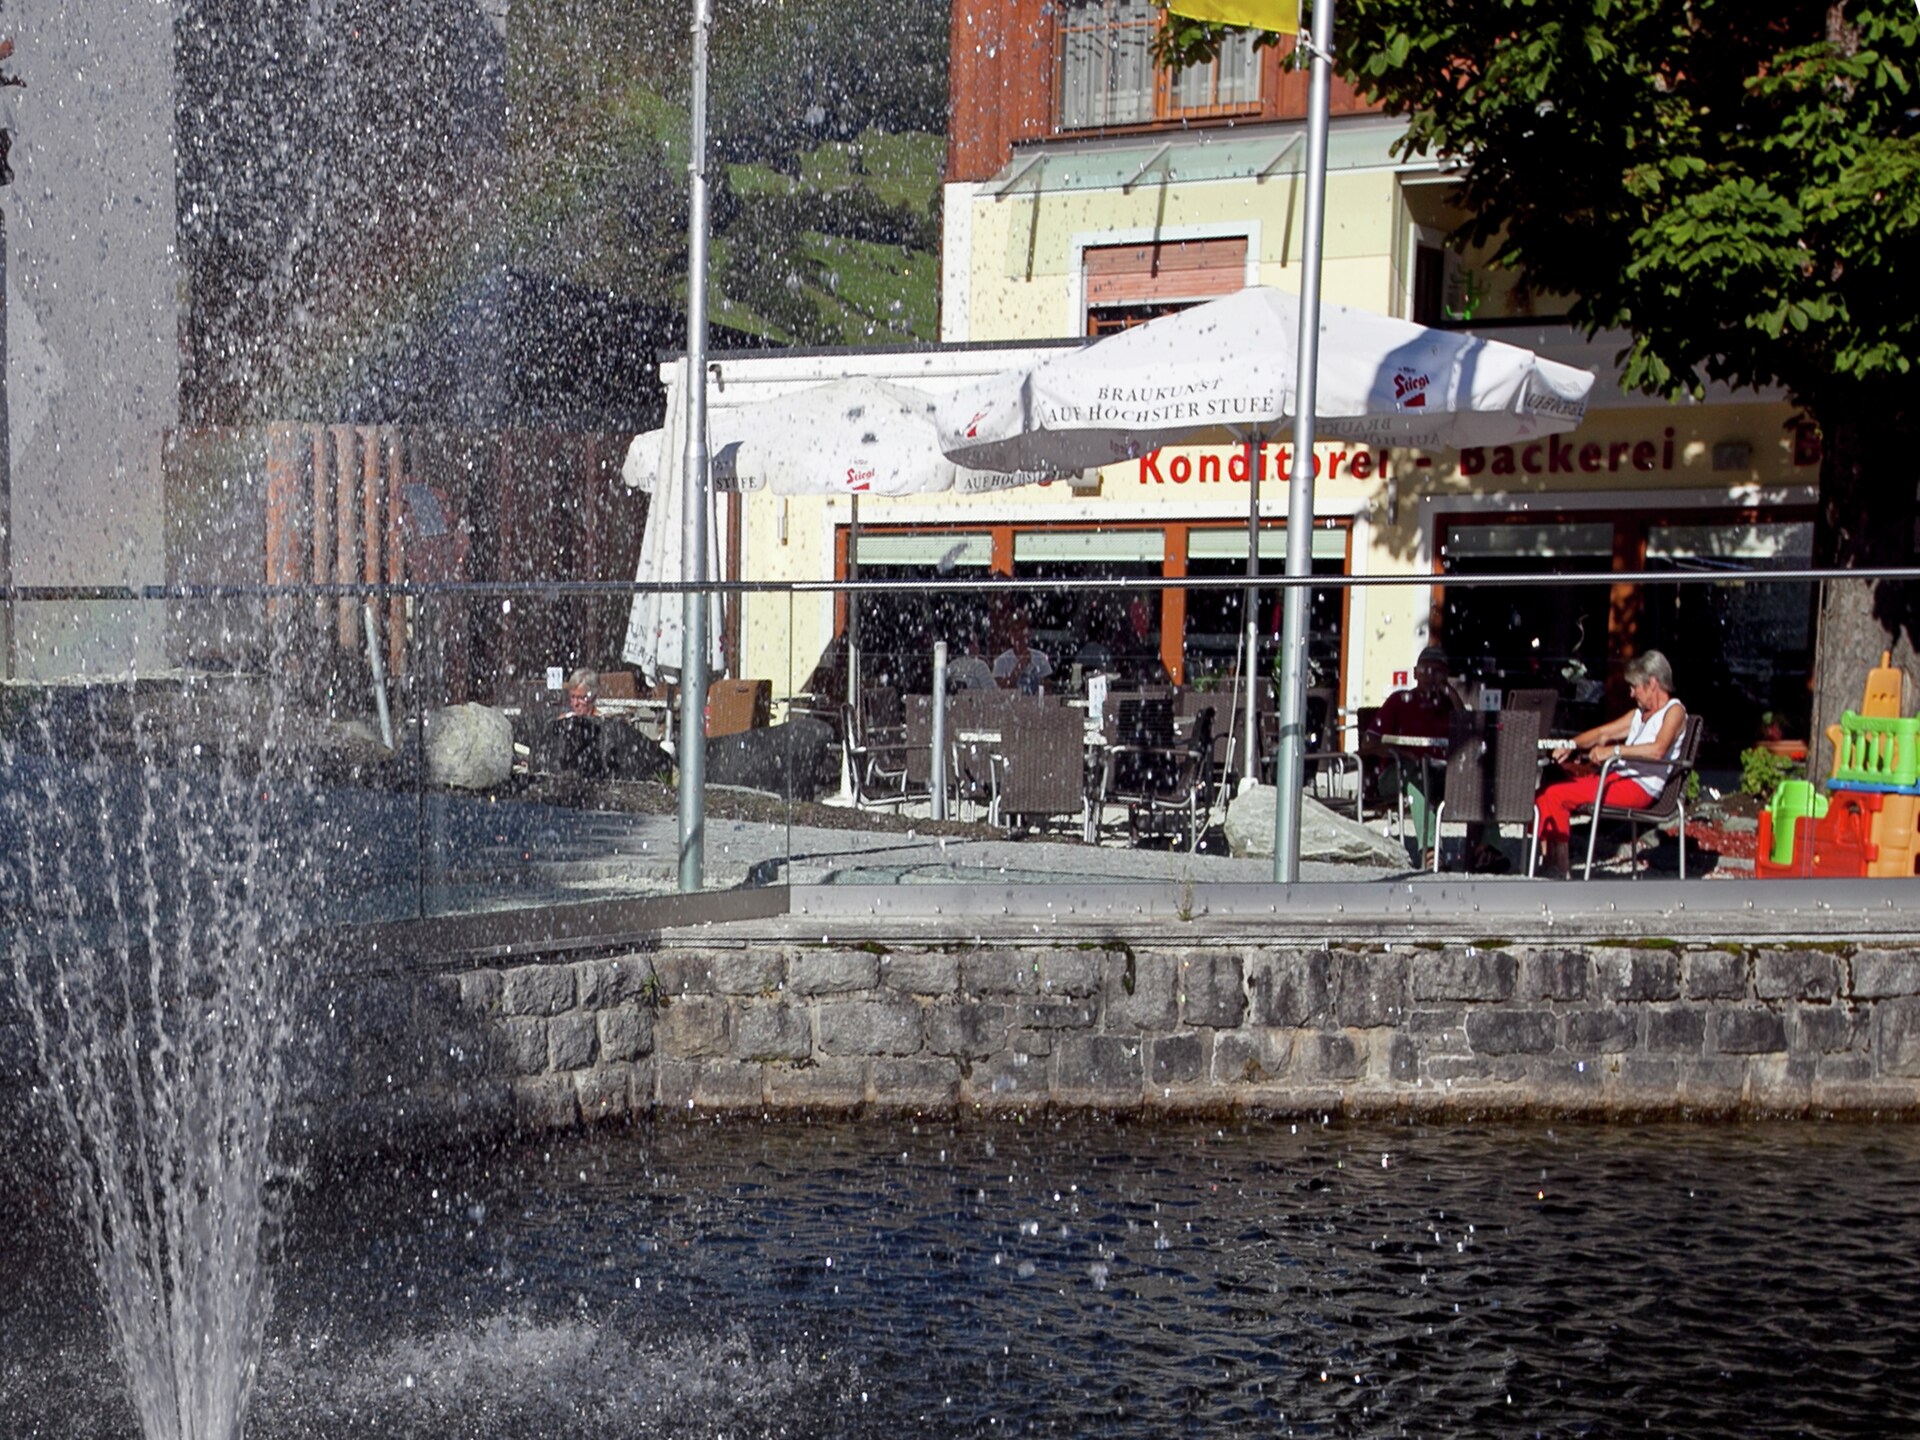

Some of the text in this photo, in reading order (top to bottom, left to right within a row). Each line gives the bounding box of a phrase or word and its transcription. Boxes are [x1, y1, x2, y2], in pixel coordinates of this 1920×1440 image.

[1097, 377, 1223, 401] BRAUKUNST
[1393, 373, 1430, 400] Stiegl
[1047, 406, 1081, 422] AUF
[1206, 397, 1274, 415] STUFE
[846, 467, 876, 485] Stiegl
[964, 474, 990, 490] AUF
